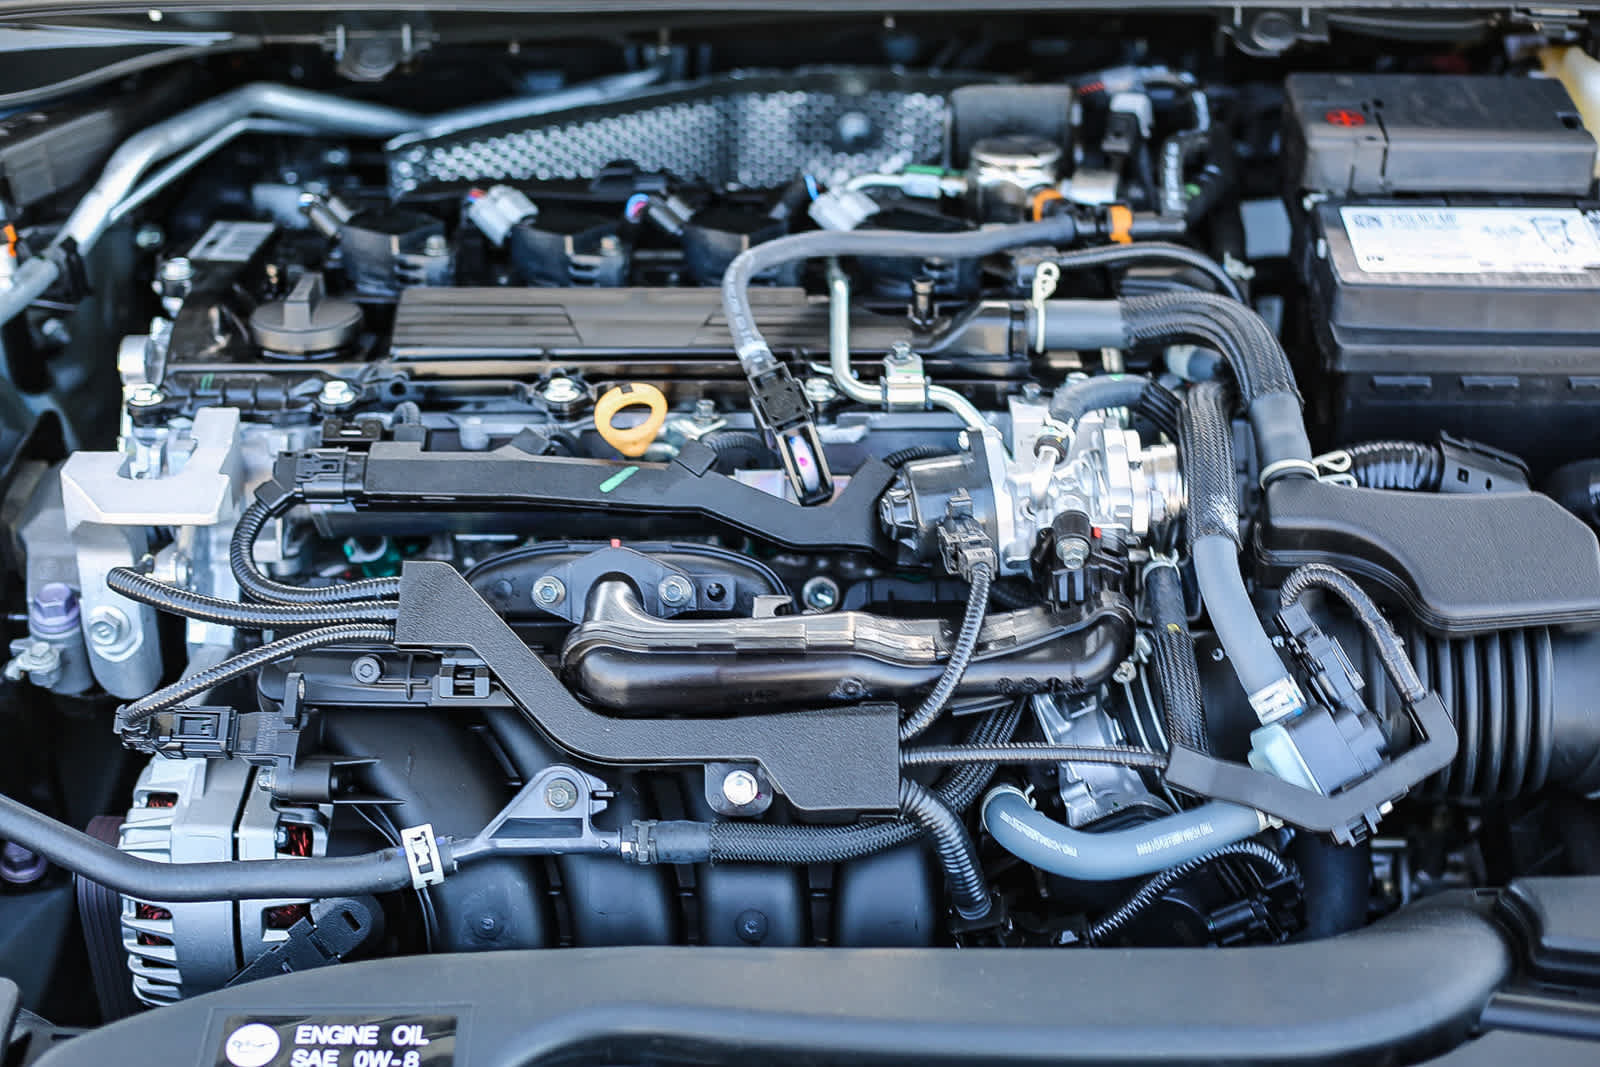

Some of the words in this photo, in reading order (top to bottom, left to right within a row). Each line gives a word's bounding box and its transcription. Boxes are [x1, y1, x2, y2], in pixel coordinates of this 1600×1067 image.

[295, 1025, 380, 1045] ENGINE
[391, 1025, 430, 1046] OIL
[290, 1049, 340, 1067] SAE
[353, 1050, 420, 1067] 0W-8
